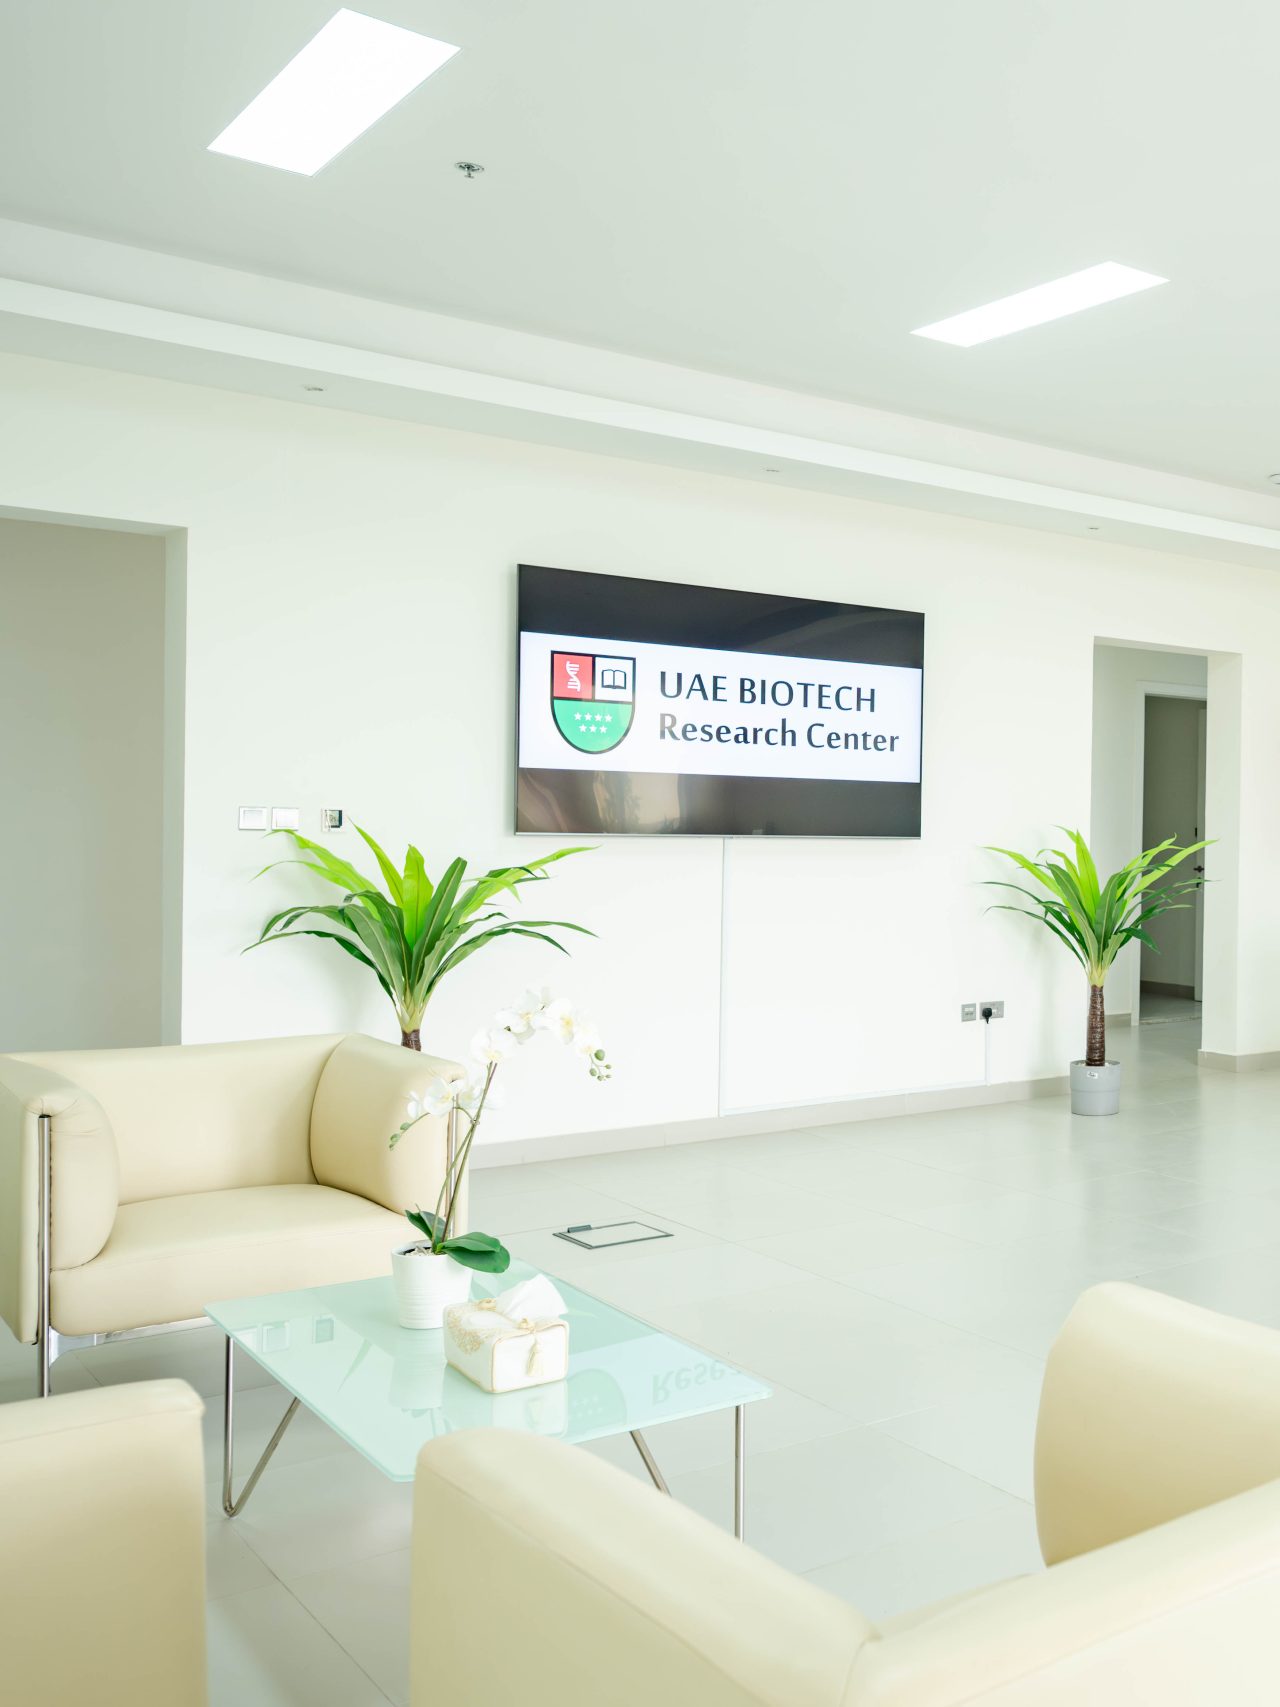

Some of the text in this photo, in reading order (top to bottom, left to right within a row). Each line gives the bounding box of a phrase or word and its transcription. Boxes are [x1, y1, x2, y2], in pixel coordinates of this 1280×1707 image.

[659, 671, 876, 713] UAE BIOTECH
[659, 712, 900, 752] Research Center
